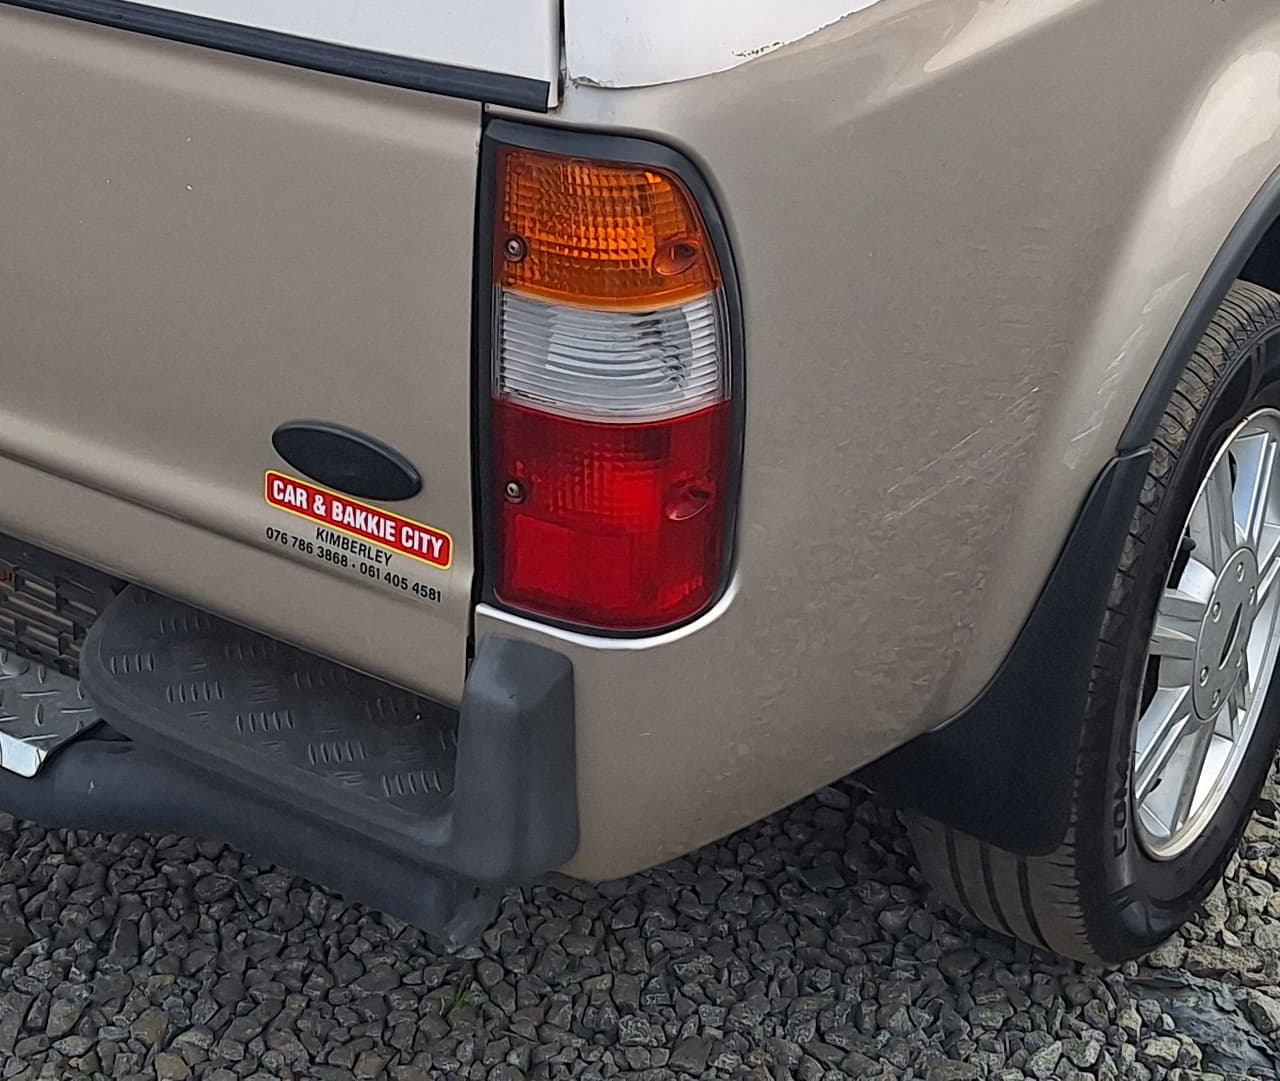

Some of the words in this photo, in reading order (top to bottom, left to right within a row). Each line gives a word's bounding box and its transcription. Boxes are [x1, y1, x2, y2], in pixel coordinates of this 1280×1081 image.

[273, 479, 307, 510] CAR
[312, 494, 326, 516] &
[331, 500, 396, 542] BAKKIE
[401, 526, 444, 559] CITY
[316, 527, 393, 567] KIMBERLEY
[265, 527, 288, 545] 076
[291, 536, 313, 554] 786
[317, 546, 348, 568] 3868
[359, 562, 380, 580] 061
[384, 572, 408, 591] 405
[412, 582, 441, 603] 4581
